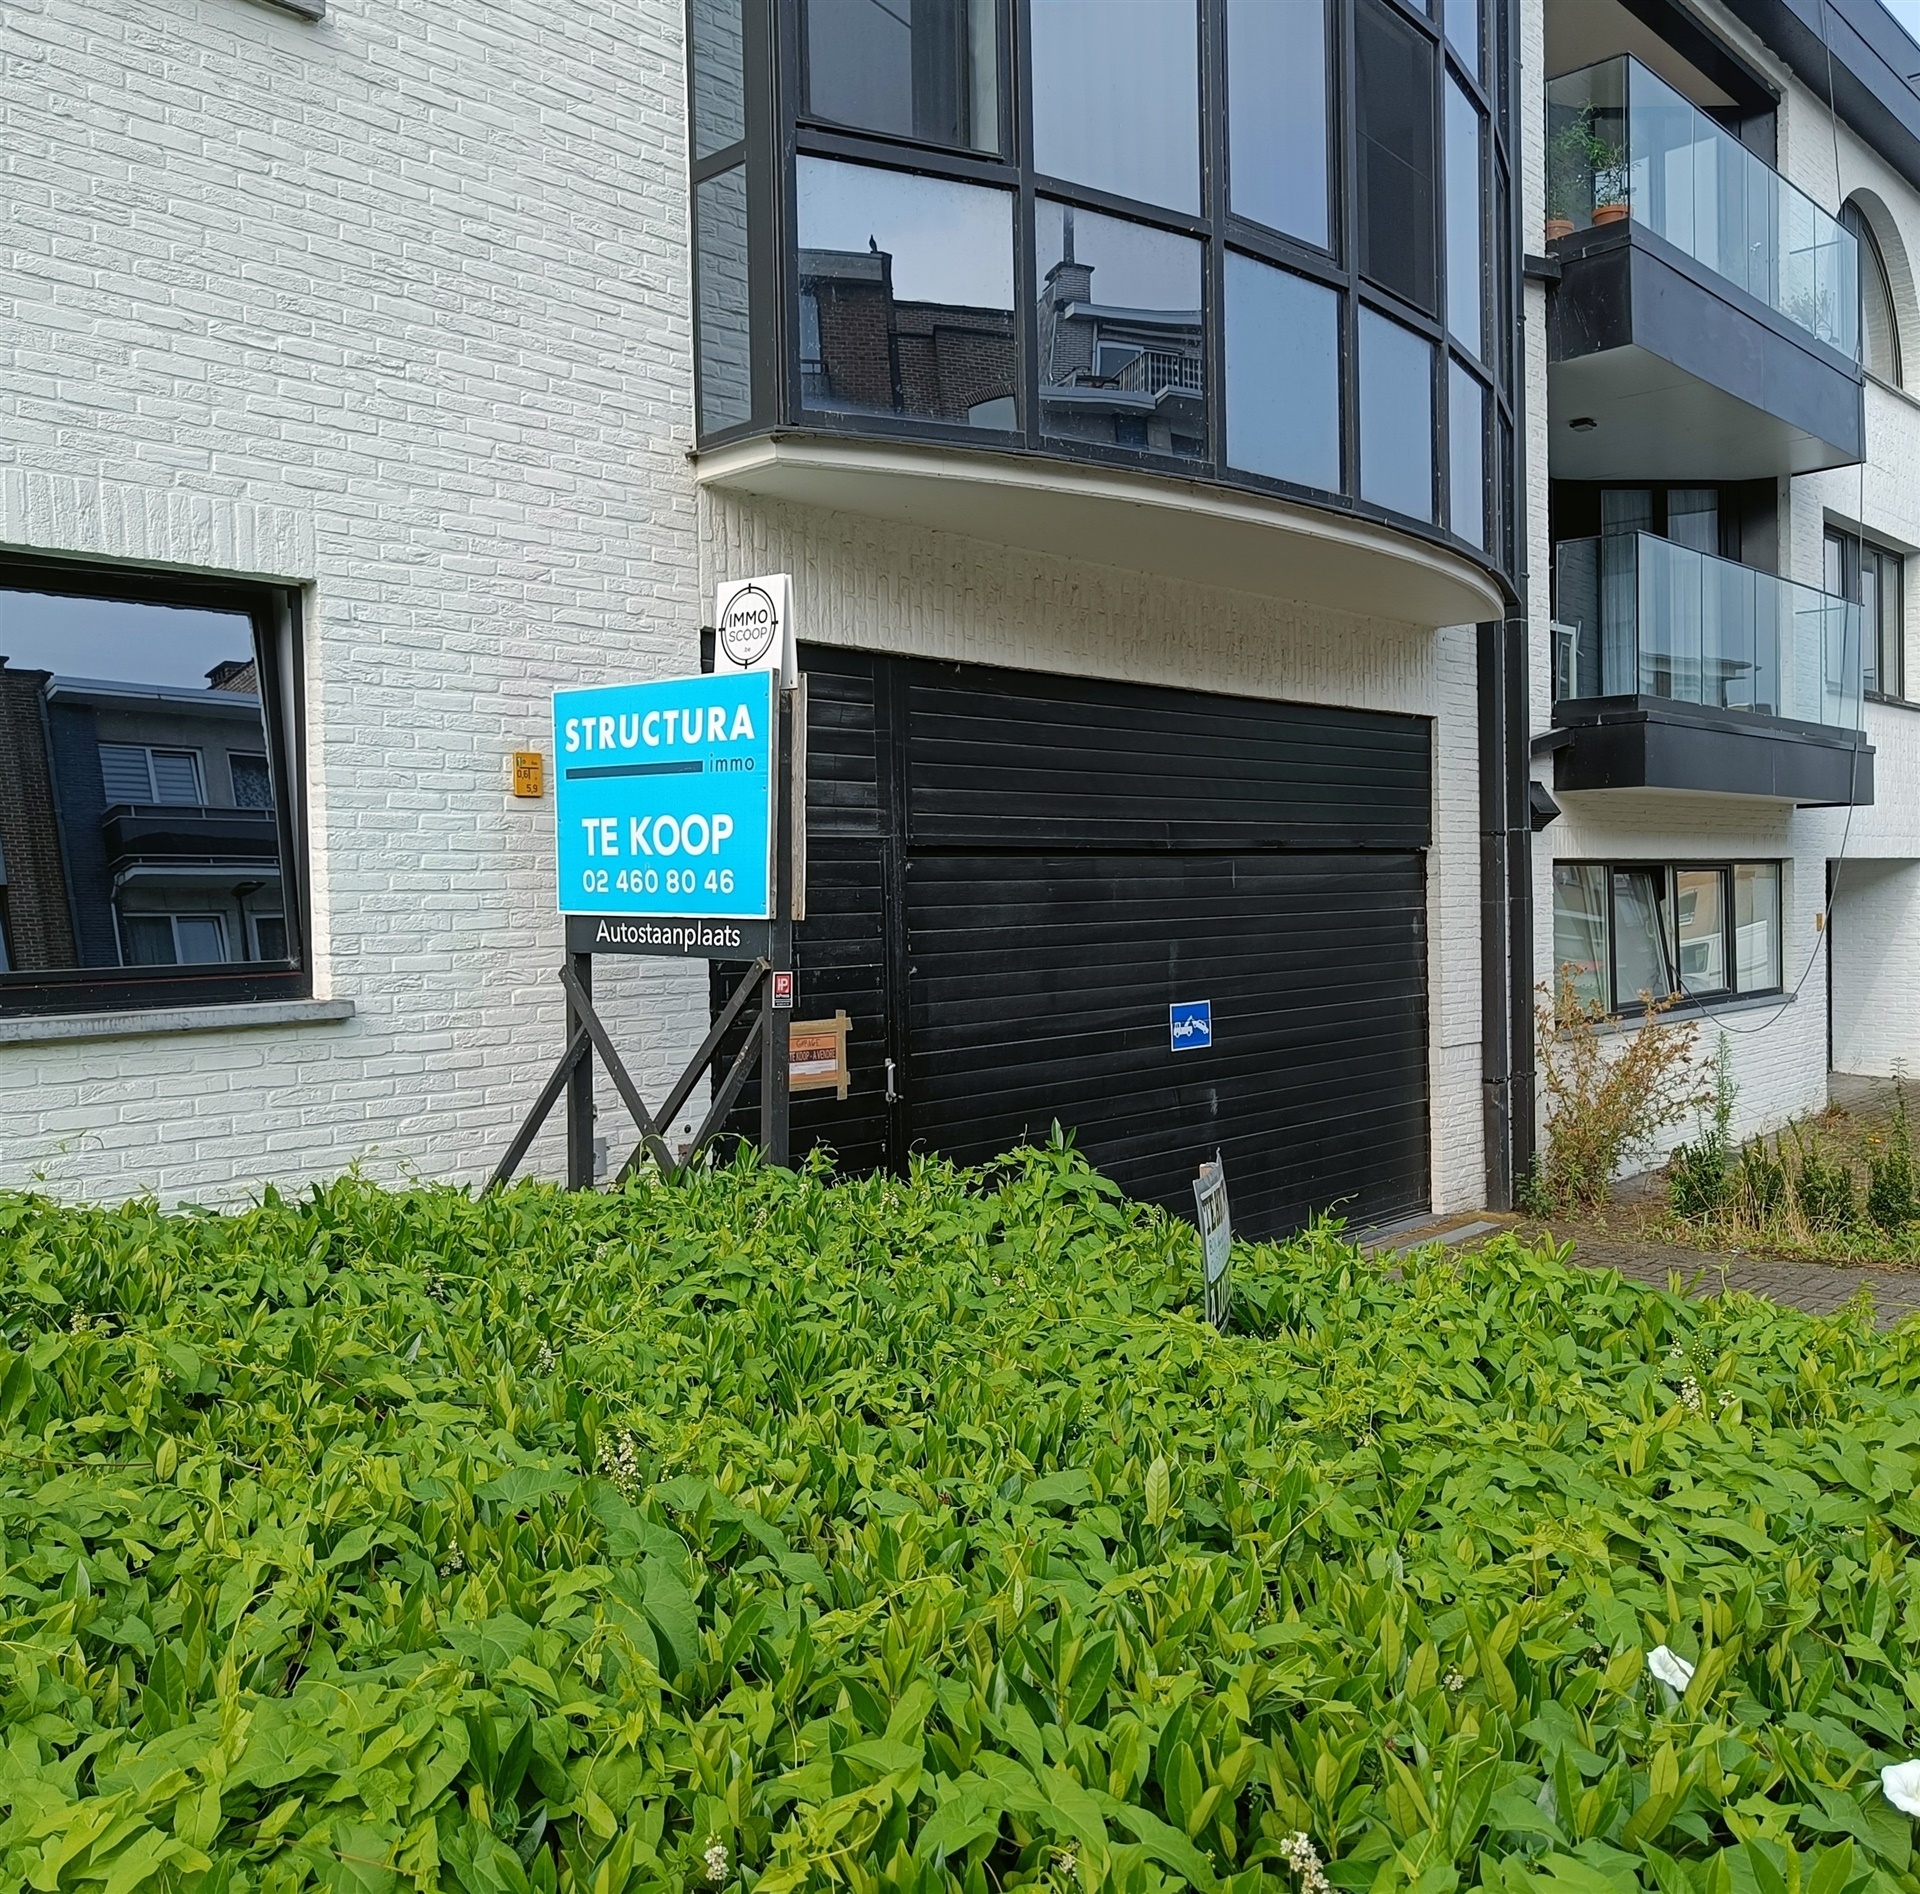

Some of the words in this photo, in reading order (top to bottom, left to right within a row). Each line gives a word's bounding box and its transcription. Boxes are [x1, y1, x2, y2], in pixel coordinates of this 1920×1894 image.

[729, 609, 768, 628] IMMO
[728, 627, 768, 643] SCOOP
[565, 703, 755, 753] STRUCTURA
[709, 753, 755, 773] immo
[526, 783, 538, 794] 5,9
[581, 817, 619, 856] TE
[629, 813, 734, 856] KOOP
[582, 869, 609, 893] 02
[616, 869, 658, 894] 460
[666, 869, 696, 894] 80
[704, 869, 734, 894] 46
[596, 919, 741, 952] Autostaanplaats
[796, 1050, 809, 1061] KOOP
[817, 1048, 836, 1060] VENDRE
